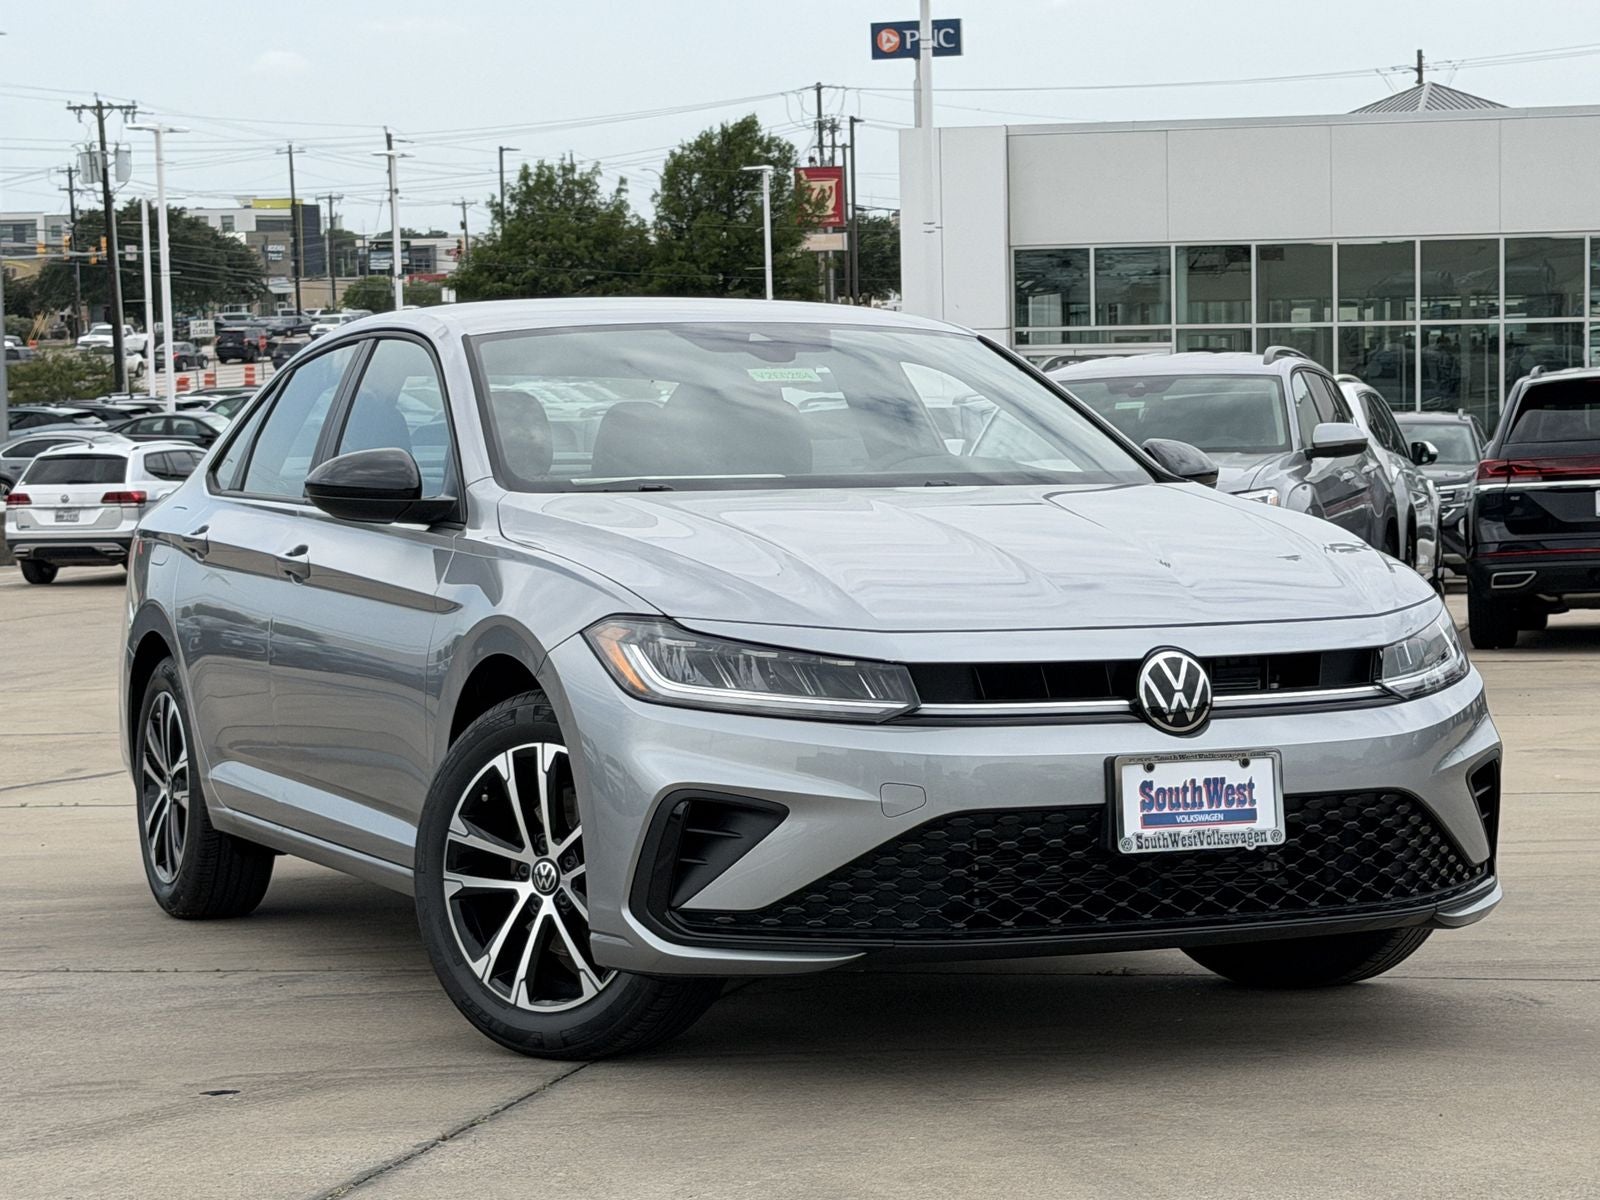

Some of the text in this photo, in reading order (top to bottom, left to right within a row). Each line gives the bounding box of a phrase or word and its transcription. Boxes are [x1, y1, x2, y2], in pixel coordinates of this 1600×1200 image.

[1139, 650, 1211, 732] VW
[1139, 776, 1257, 812] SouthWest
[1176, 813, 1224, 823] VOLKSWAGEN
[534, 861, 557, 893] VW
